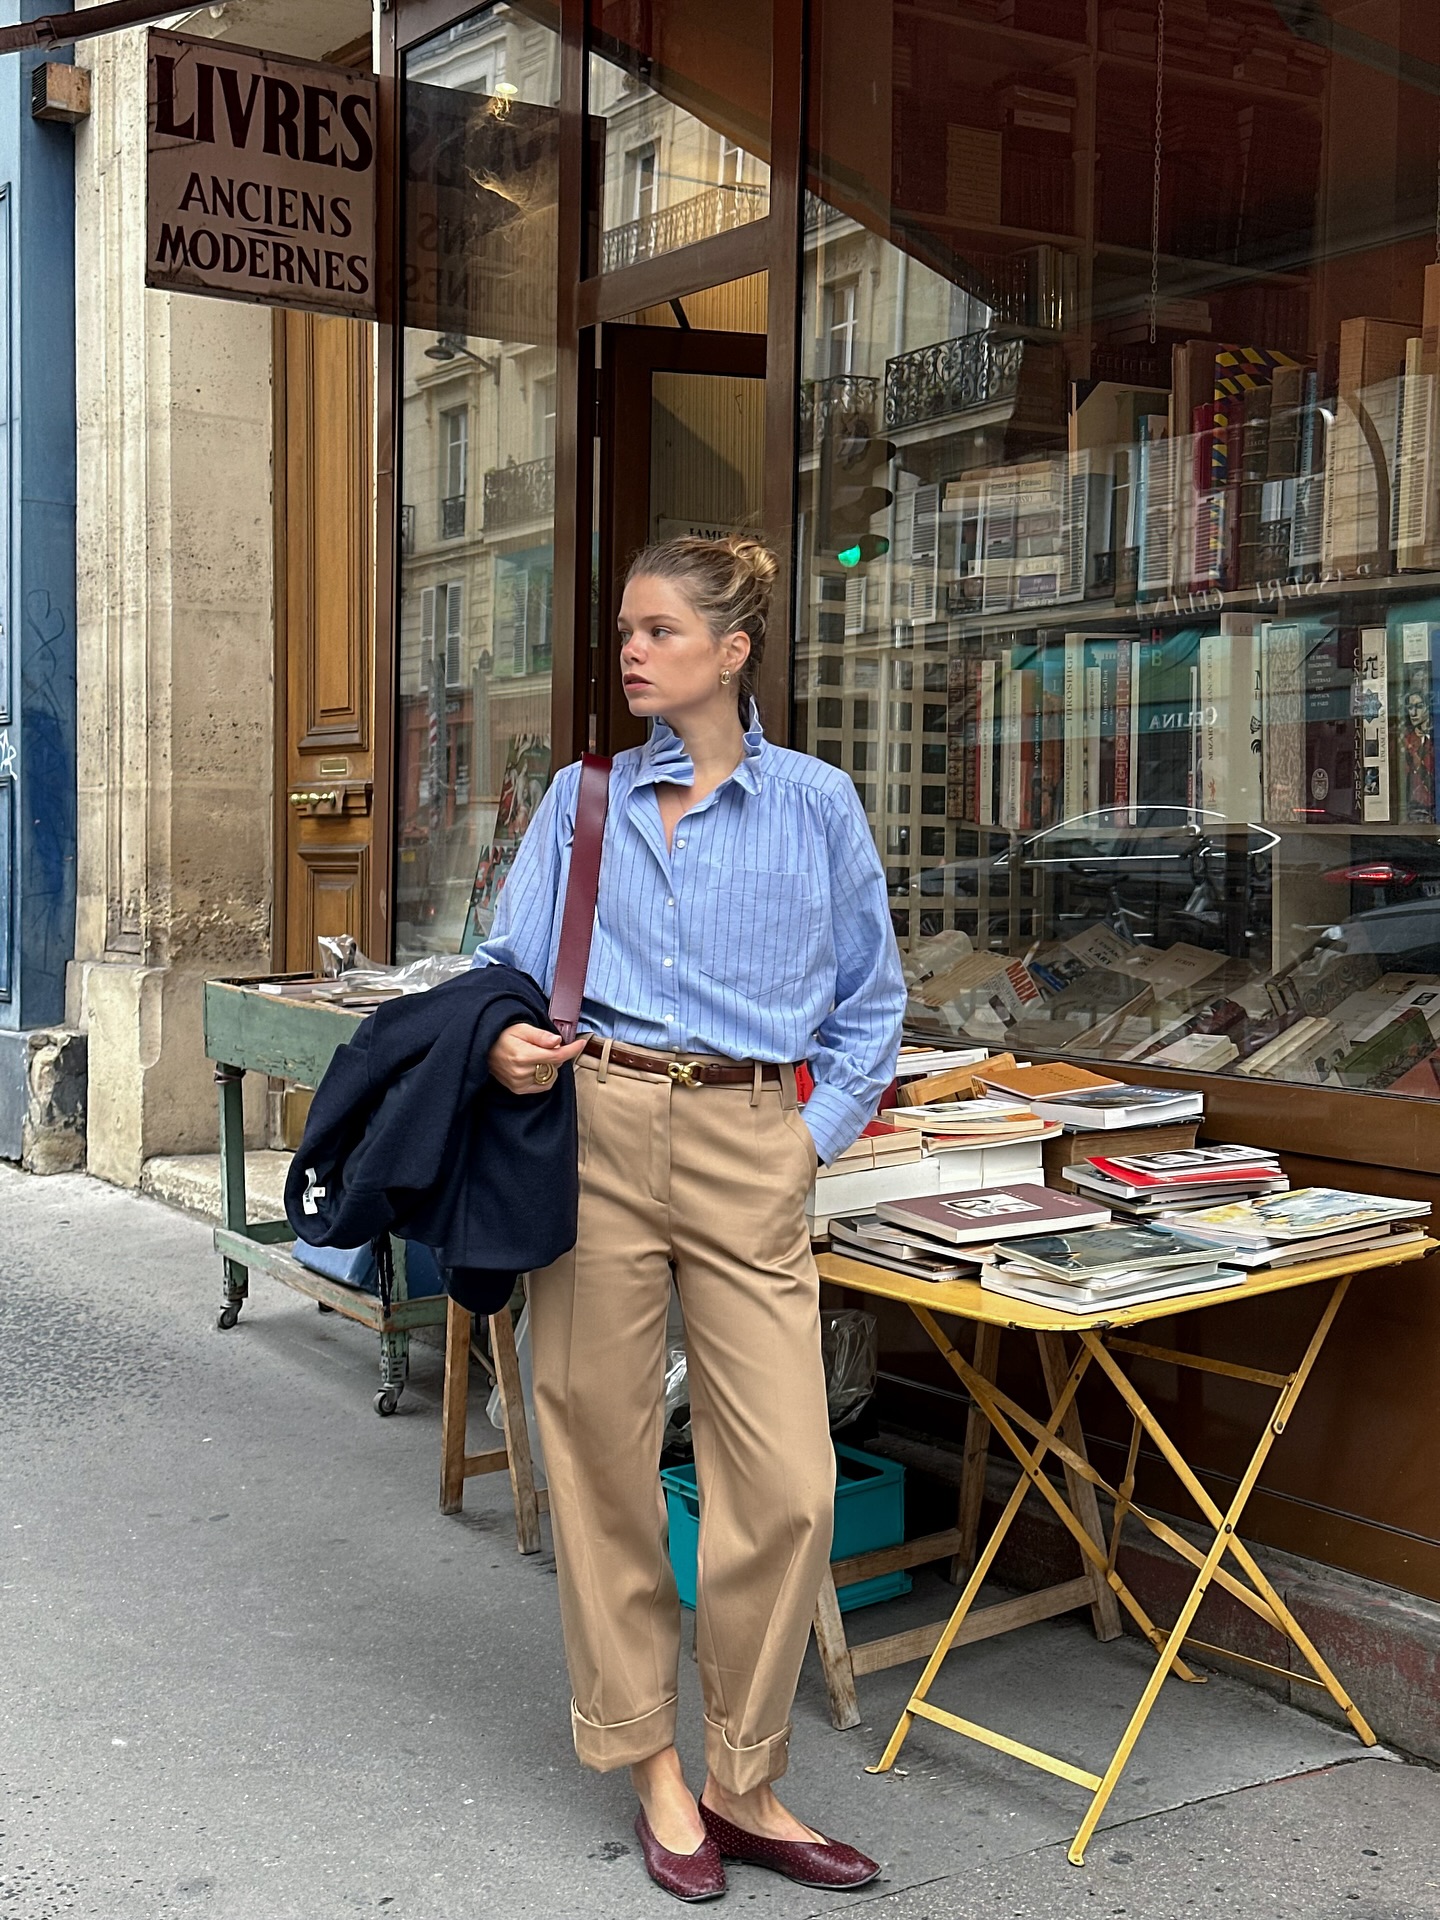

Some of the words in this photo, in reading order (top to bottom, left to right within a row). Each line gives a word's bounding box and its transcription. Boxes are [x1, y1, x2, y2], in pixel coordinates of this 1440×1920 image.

[154, 54, 373, 172] LIVRES
[177, 171, 352, 238] ANCIENS
[155, 222, 369, 295] MODERNES
[1066, 653, 1074, 721] HIROSHIGE
[1005, 960, 1040, 1005] MARX
[1087, 945, 1112, 967] L'ART
